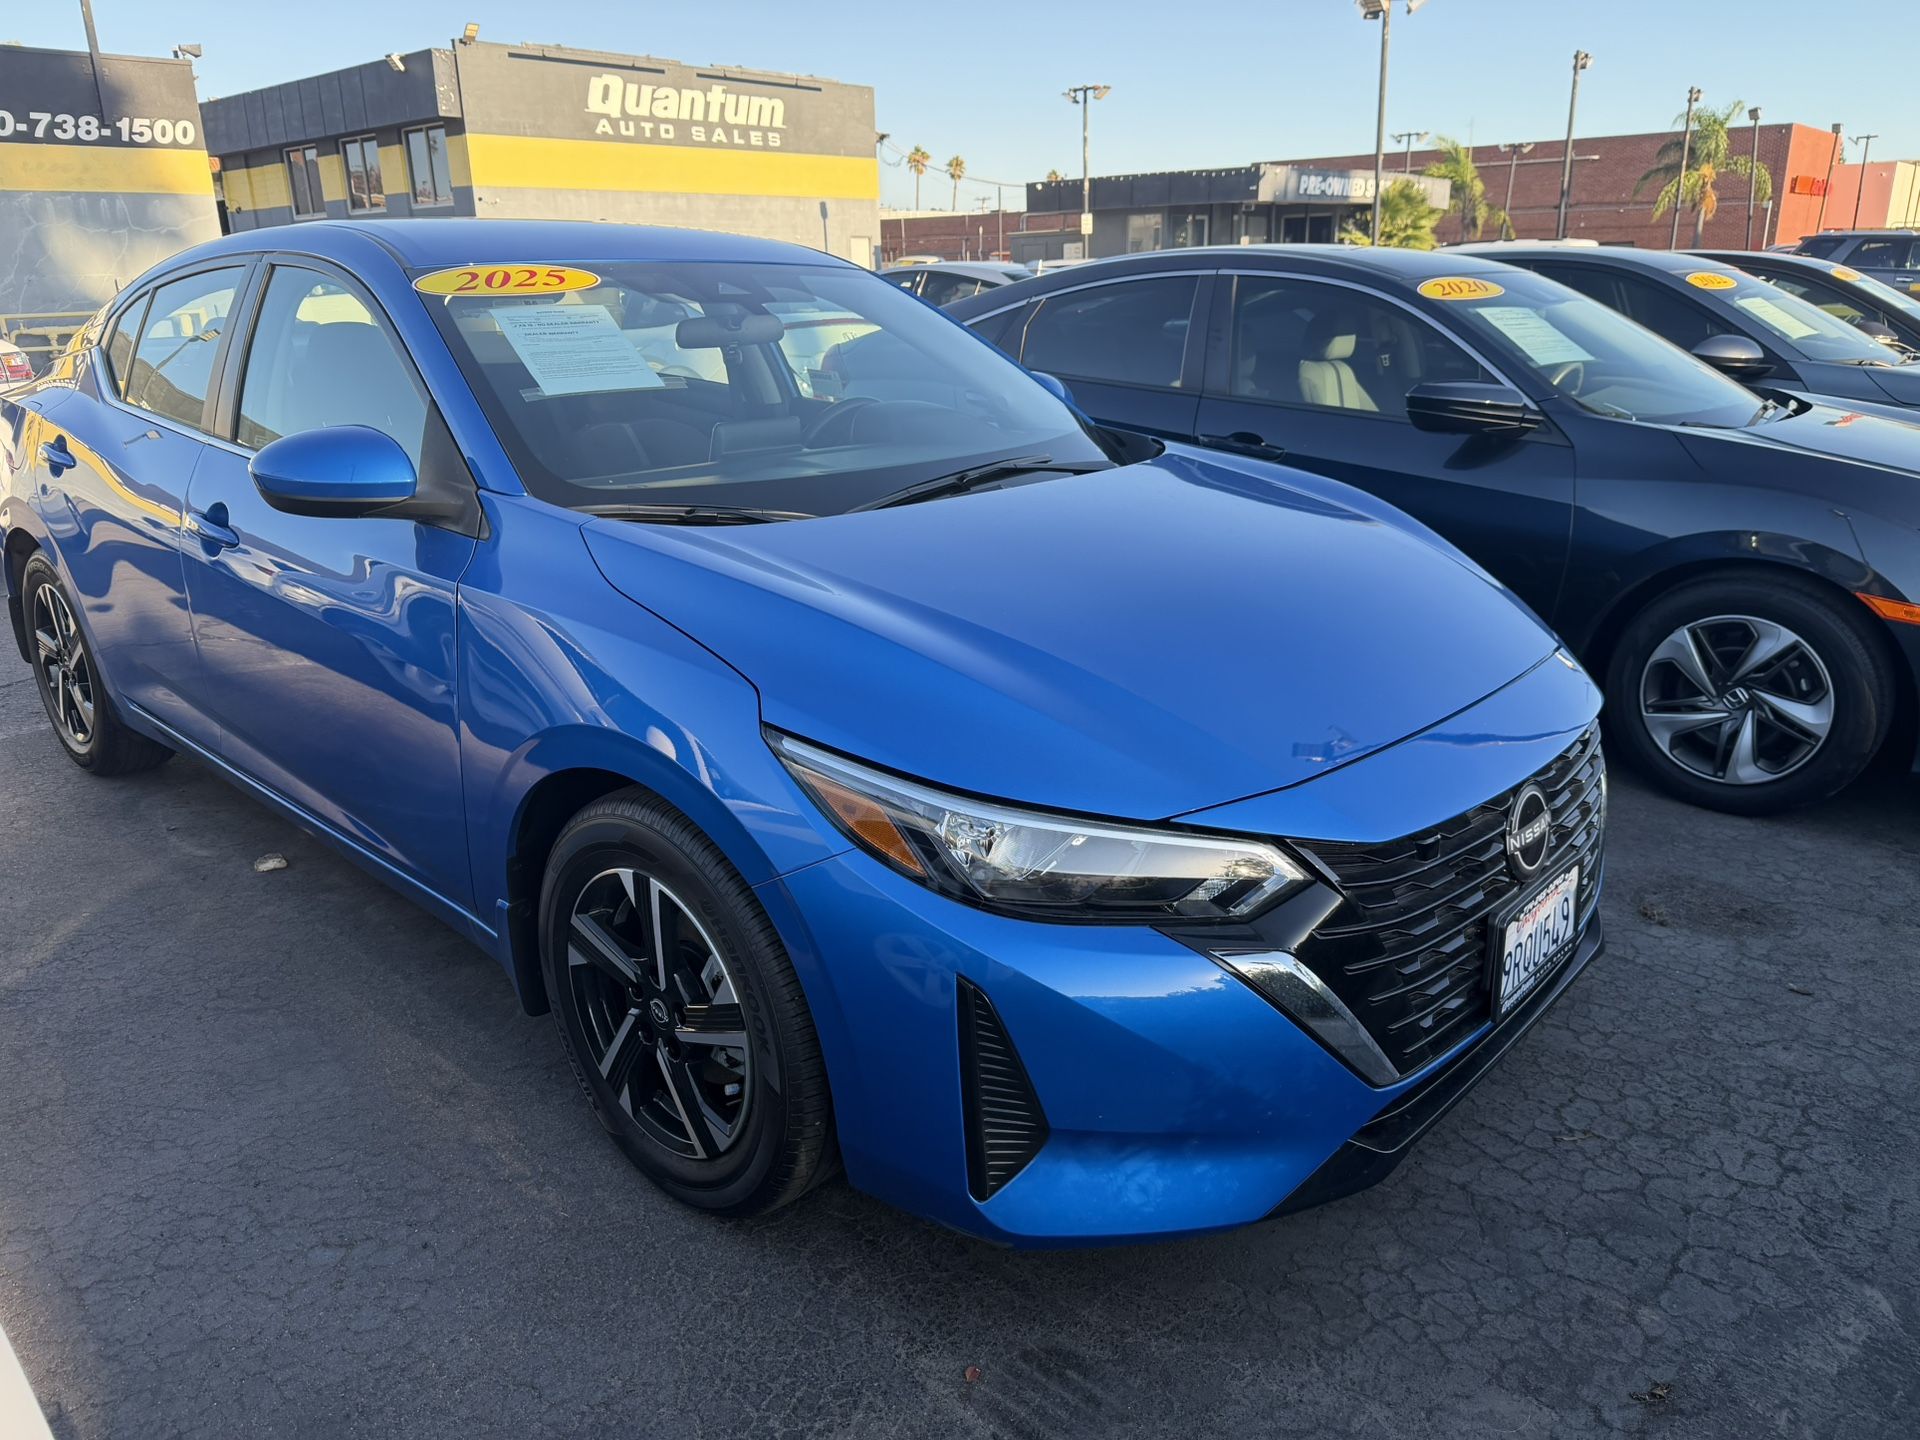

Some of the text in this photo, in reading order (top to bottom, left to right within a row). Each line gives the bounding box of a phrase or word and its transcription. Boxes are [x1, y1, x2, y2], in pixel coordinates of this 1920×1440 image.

[585, 74, 787, 128] Quantum
[595, 118, 781, 147] AUTO SALES
[454, 269, 566, 292] 2025
[1433, 280, 1490, 296] 2020
[1510, 813, 1551, 851] NISSAN
[1501, 897, 1570, 999] 9RQU549
